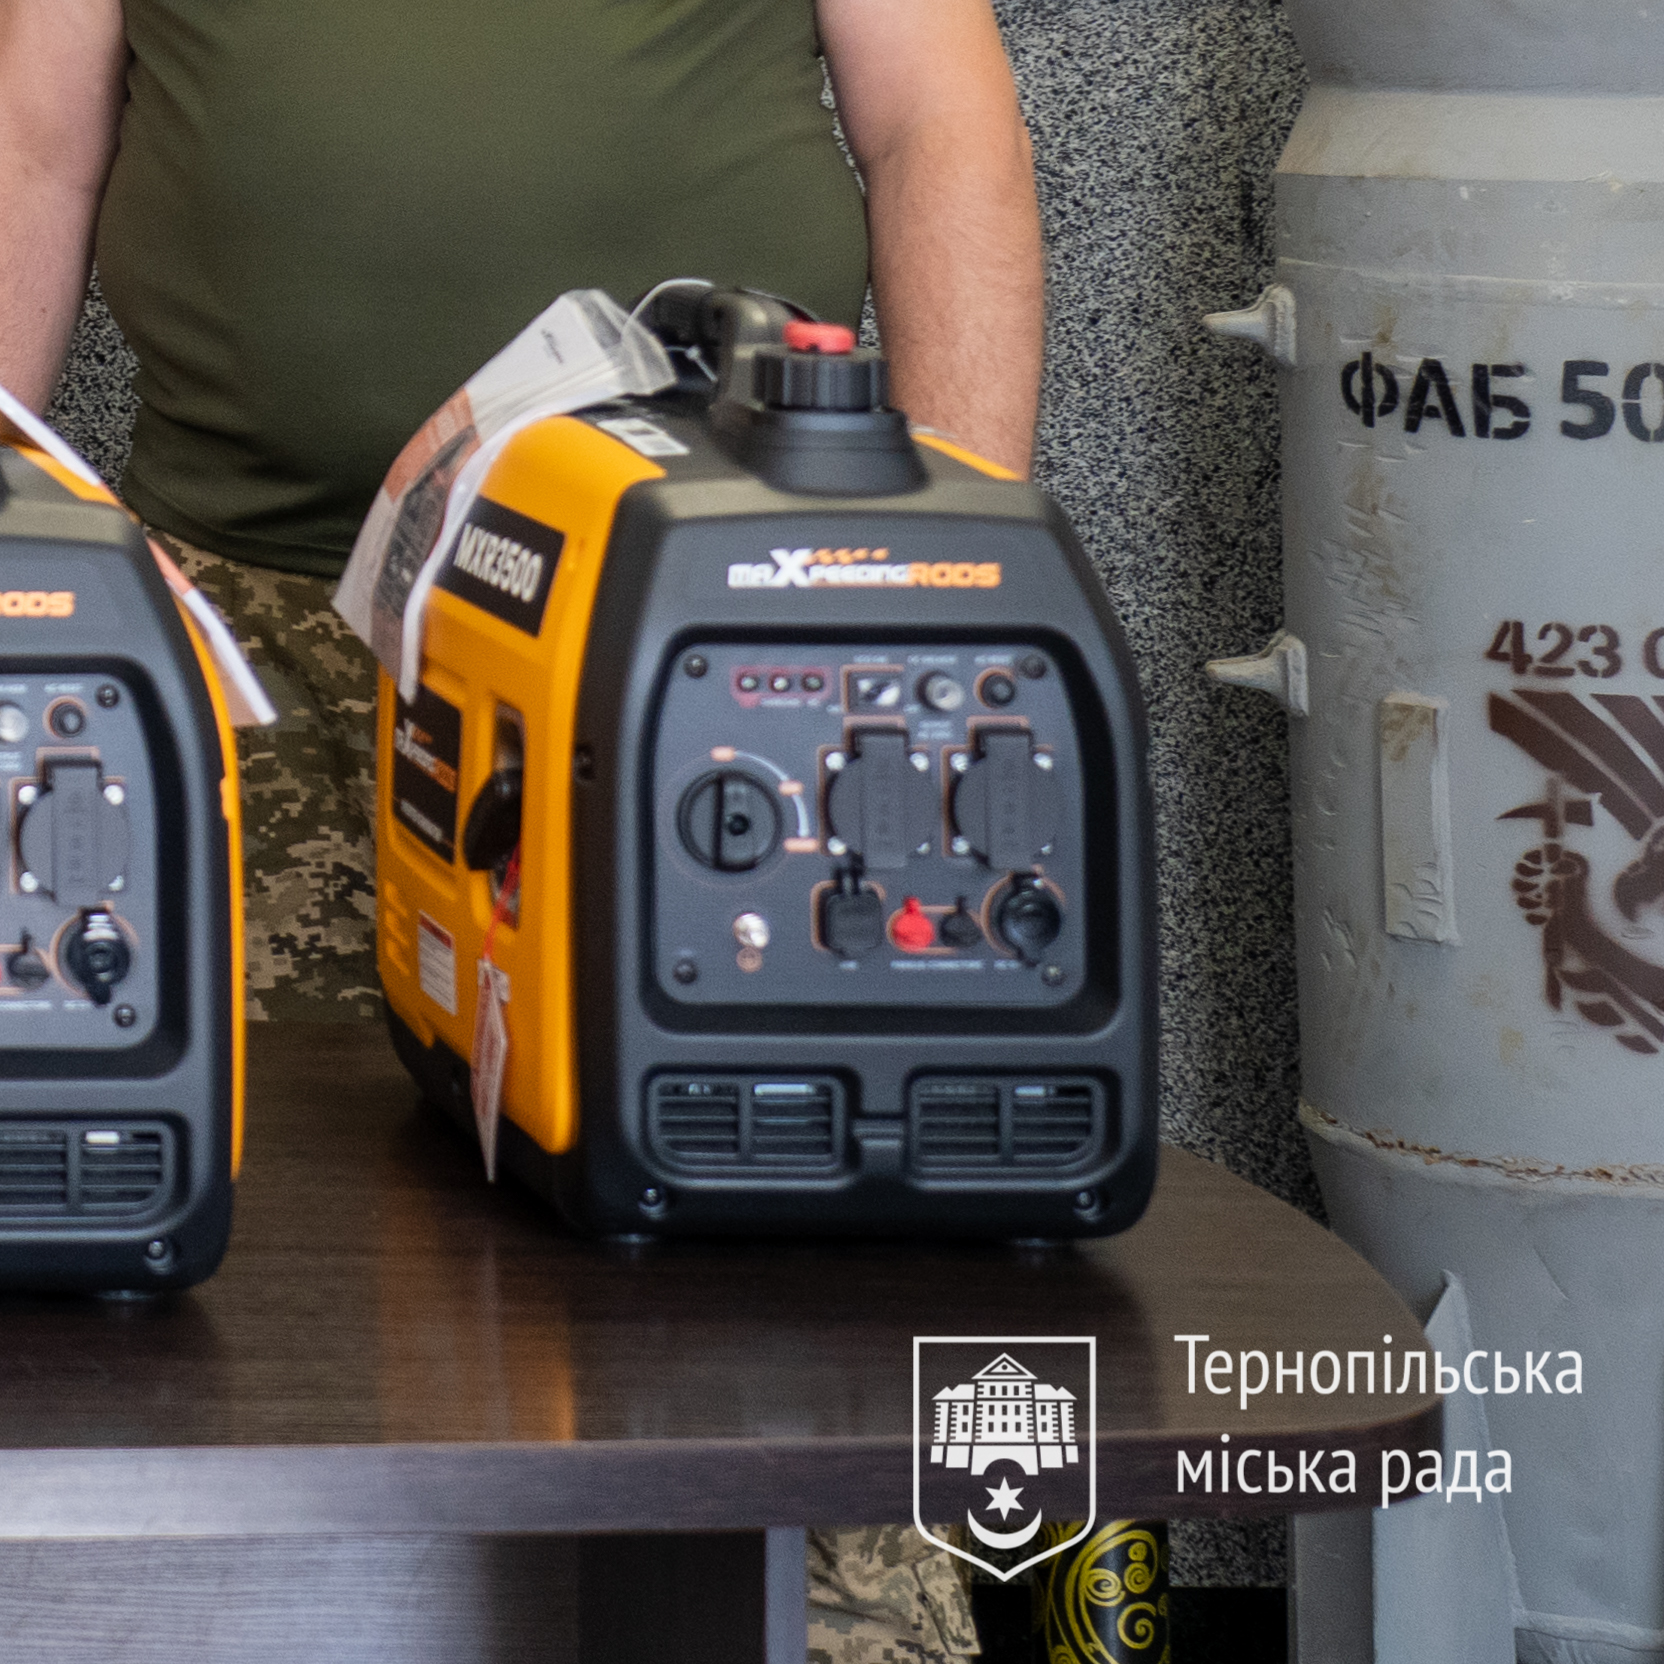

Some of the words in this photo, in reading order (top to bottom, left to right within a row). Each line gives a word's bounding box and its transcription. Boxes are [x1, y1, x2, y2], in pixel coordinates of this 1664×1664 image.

[1339, 352, 1534, 440] ФАБ
[456, 522, 544, 604] MXR3500
[1485, 619, 1622, 679] 423
